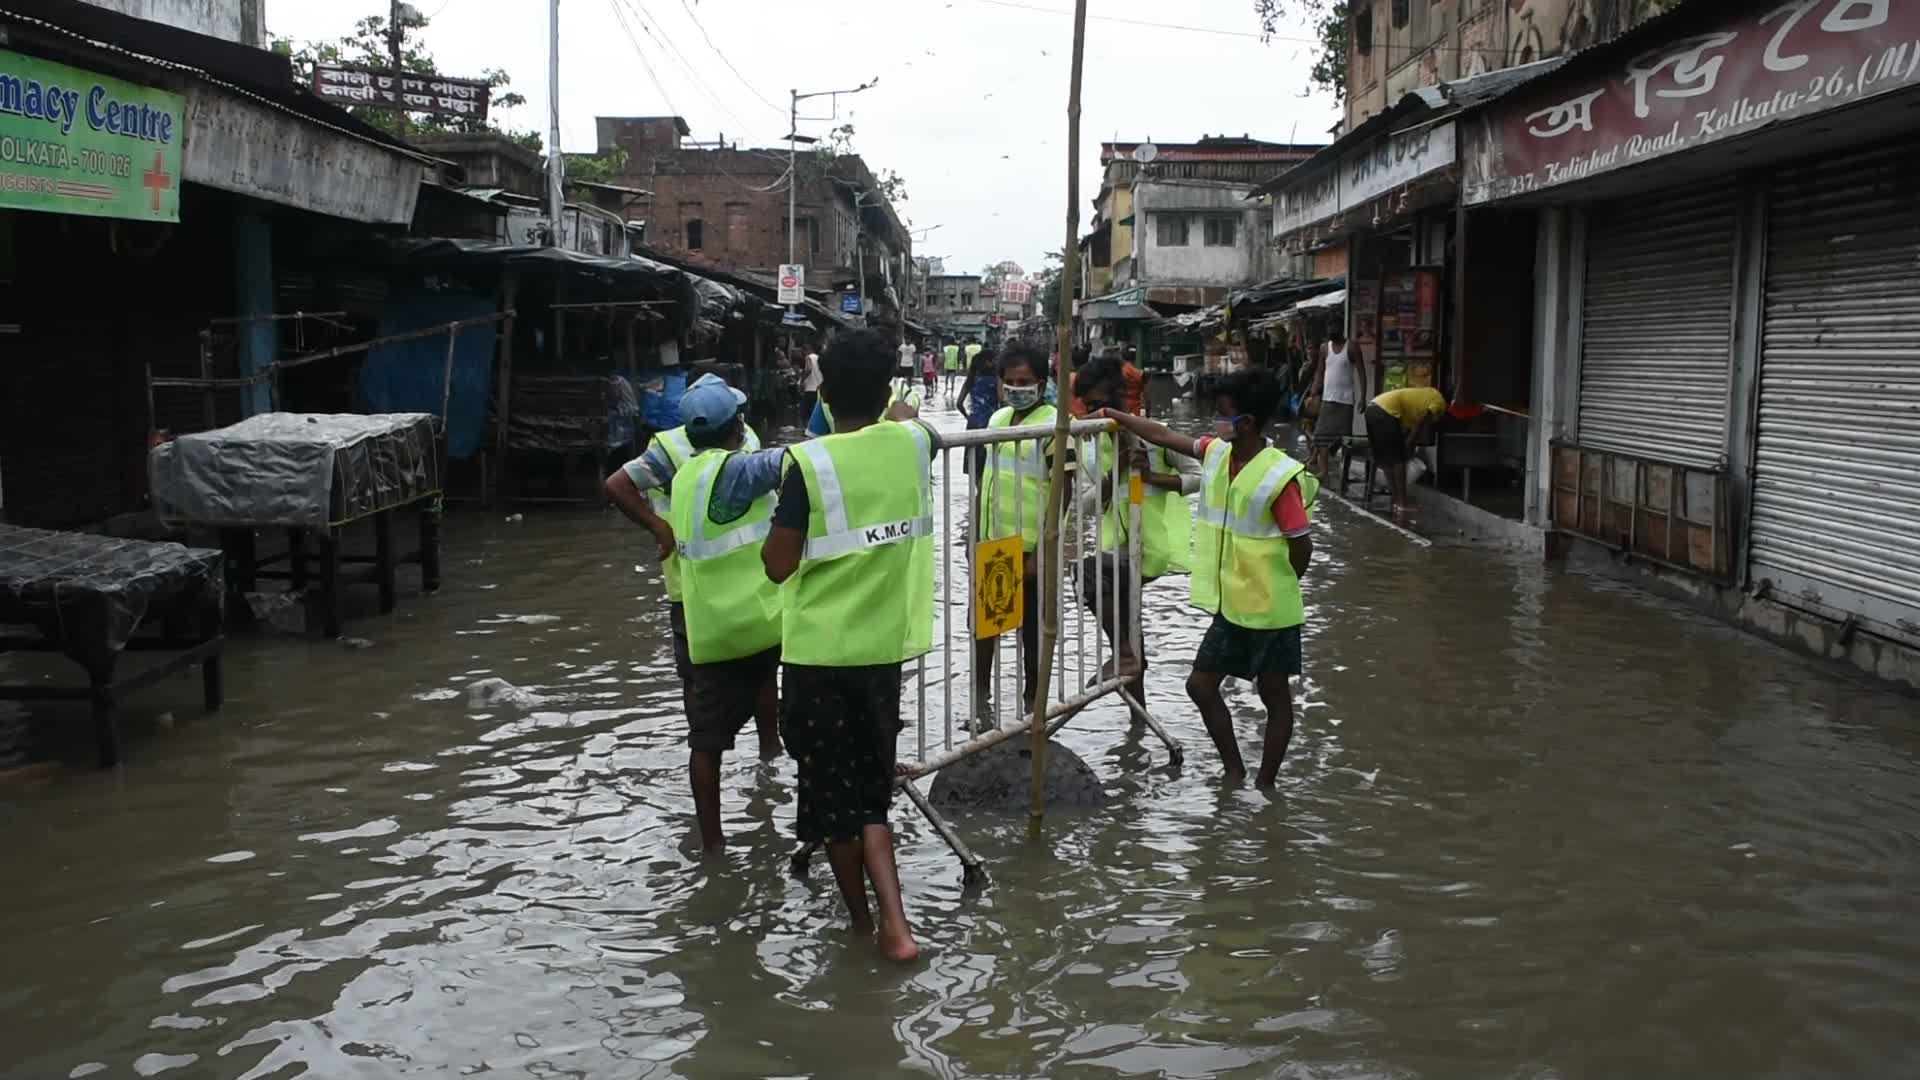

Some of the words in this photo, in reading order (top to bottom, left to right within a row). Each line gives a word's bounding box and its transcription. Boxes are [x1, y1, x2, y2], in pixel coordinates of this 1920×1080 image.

[320, 84, 377, 100] काली
[87, 84, 172, 144] Centre
[1543, 144, 1619, 186] Kalighat
